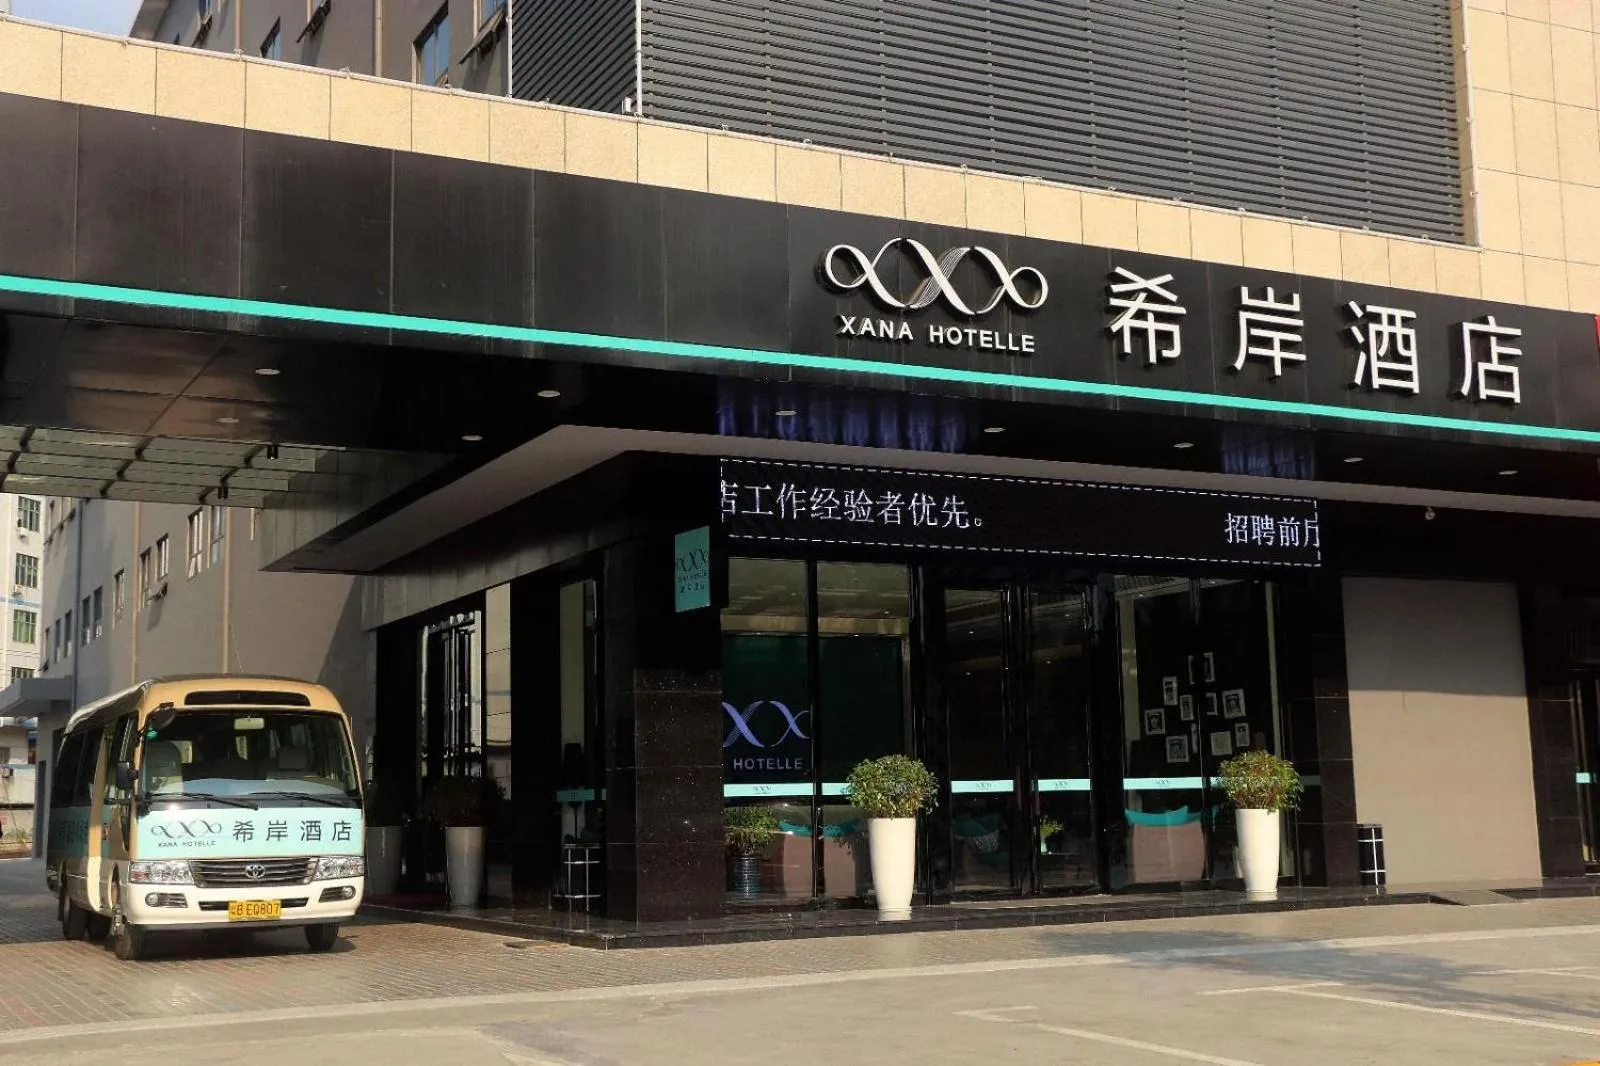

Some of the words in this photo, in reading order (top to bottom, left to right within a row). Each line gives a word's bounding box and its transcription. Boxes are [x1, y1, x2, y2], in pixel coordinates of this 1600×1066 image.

[839, 315, 914, 341] XANA
[928, 323, 1036, 353] HOTELLE
[1108, 265, 1524, 405] 希岸酒店
[732, 757, 804, 771] HOTELLE
[232, 820, 353, 843] 希岸酒店
